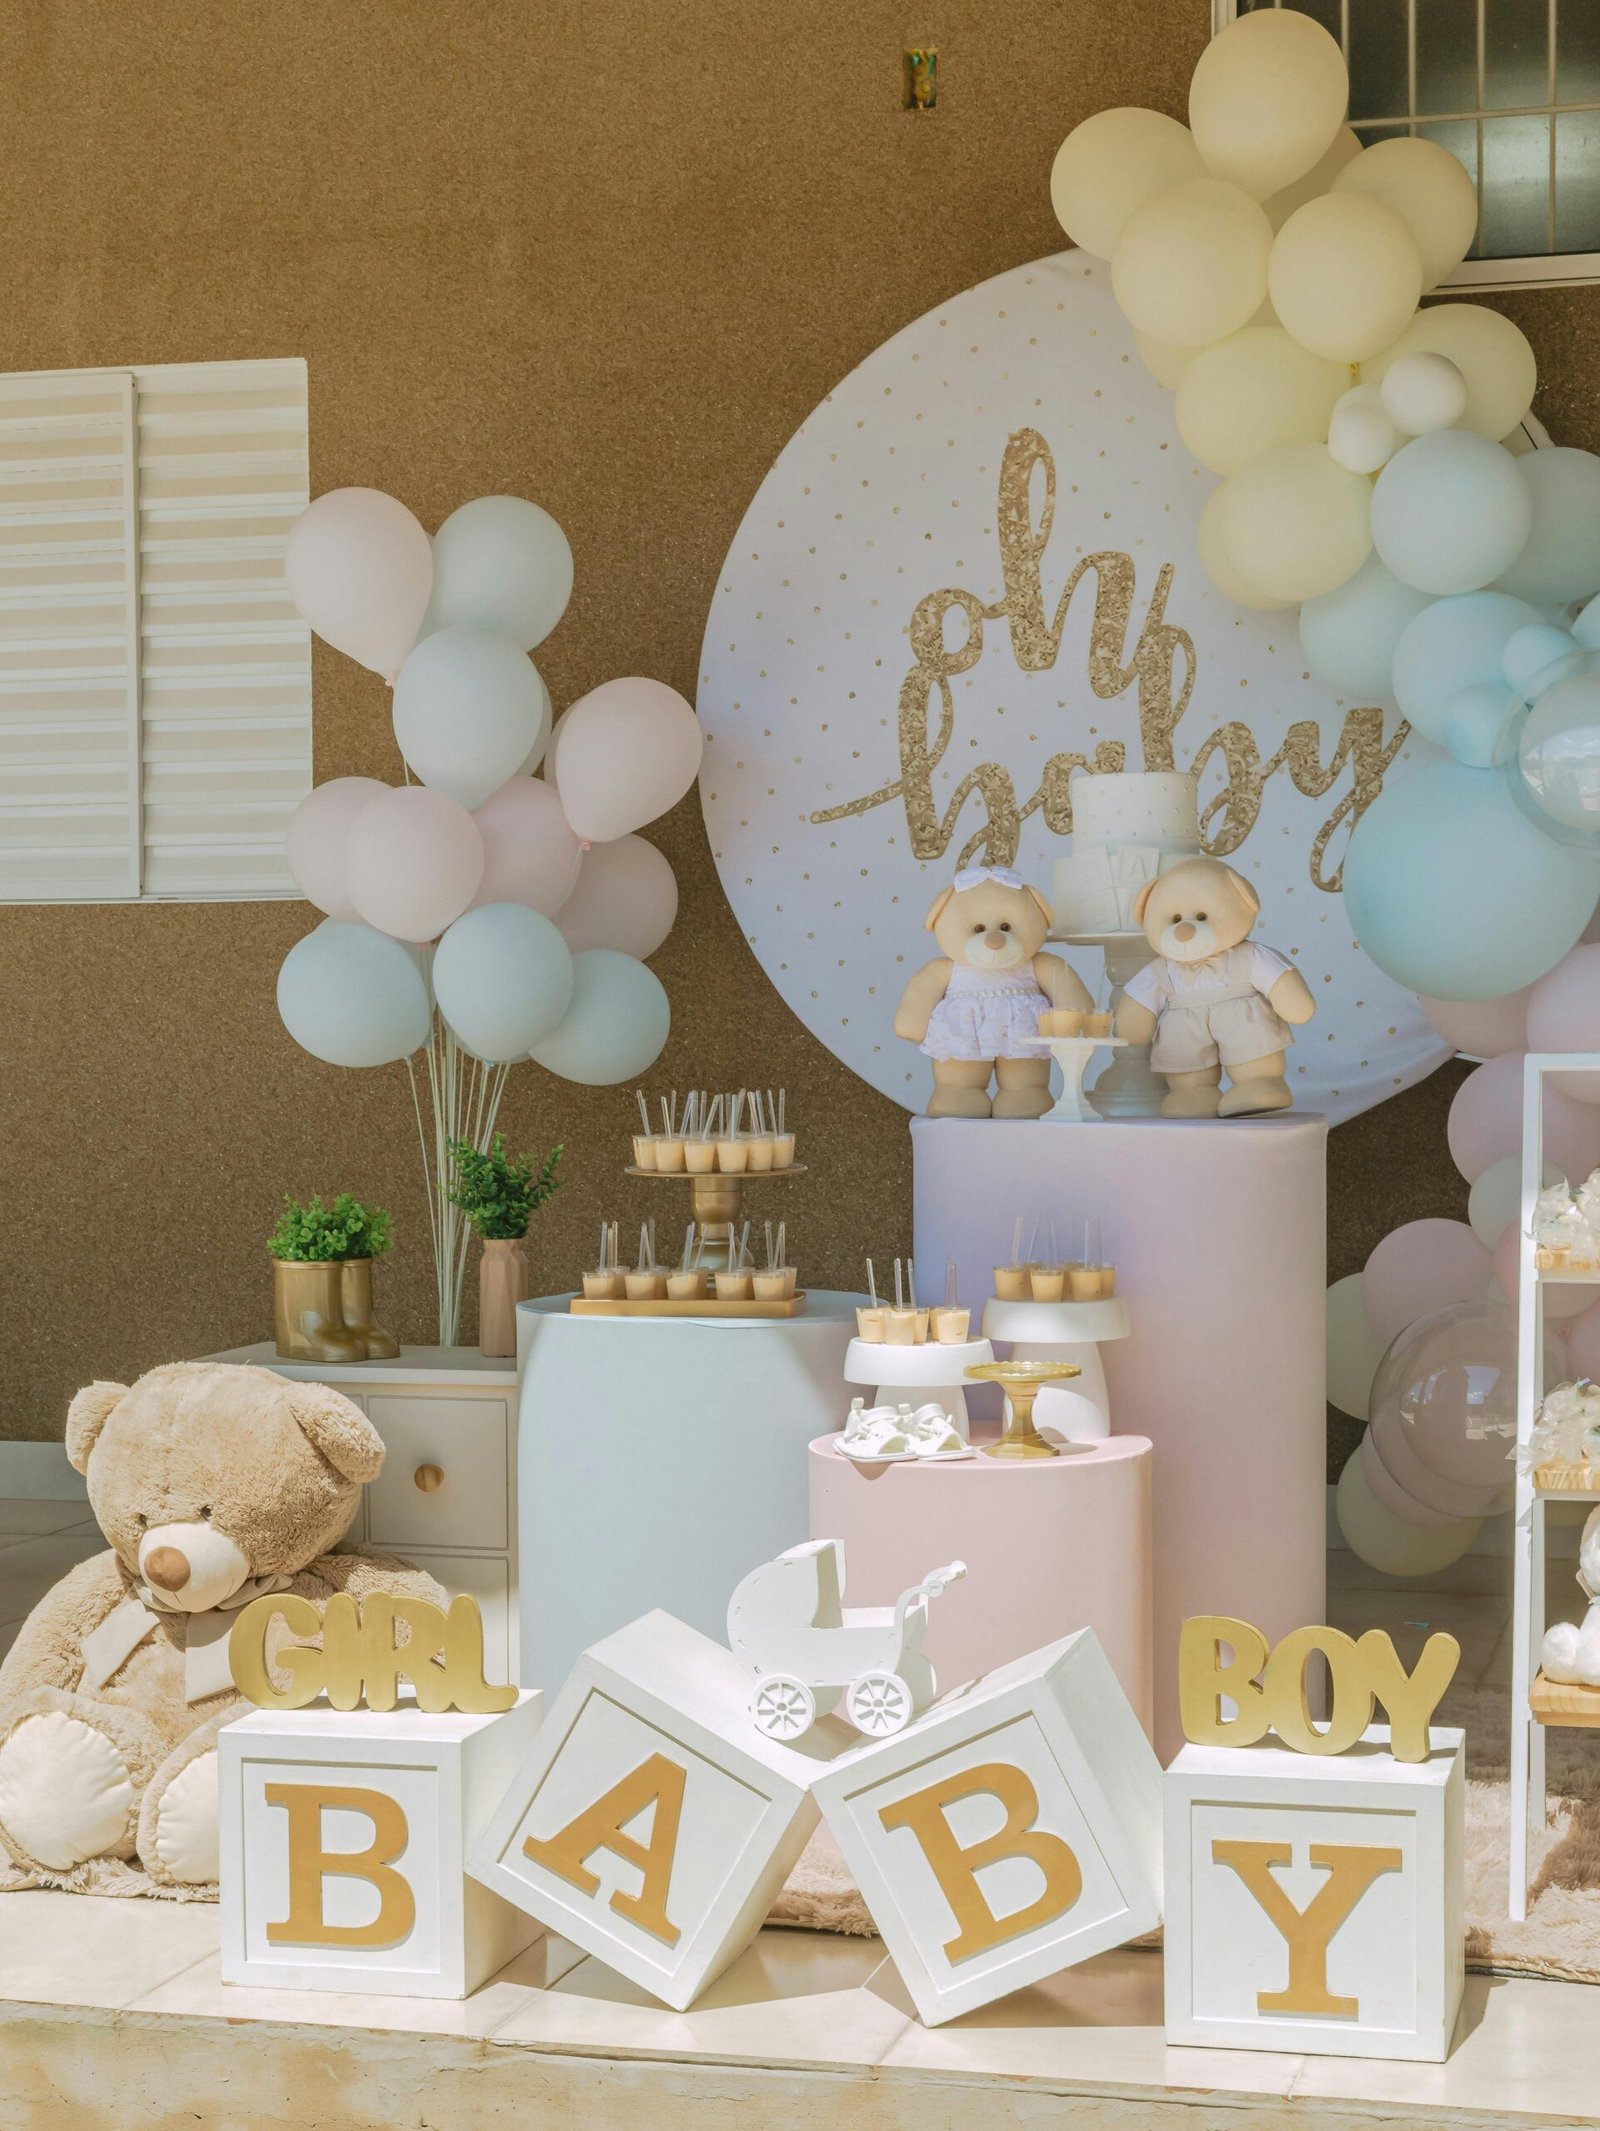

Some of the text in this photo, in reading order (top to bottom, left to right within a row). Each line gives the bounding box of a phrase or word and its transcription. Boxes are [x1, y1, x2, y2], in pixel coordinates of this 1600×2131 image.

[910, 427, 1175, 698] oh
[228, 1591, 519, 1713] GIRL
[1179, 1615, 1460, 1762] BOY
